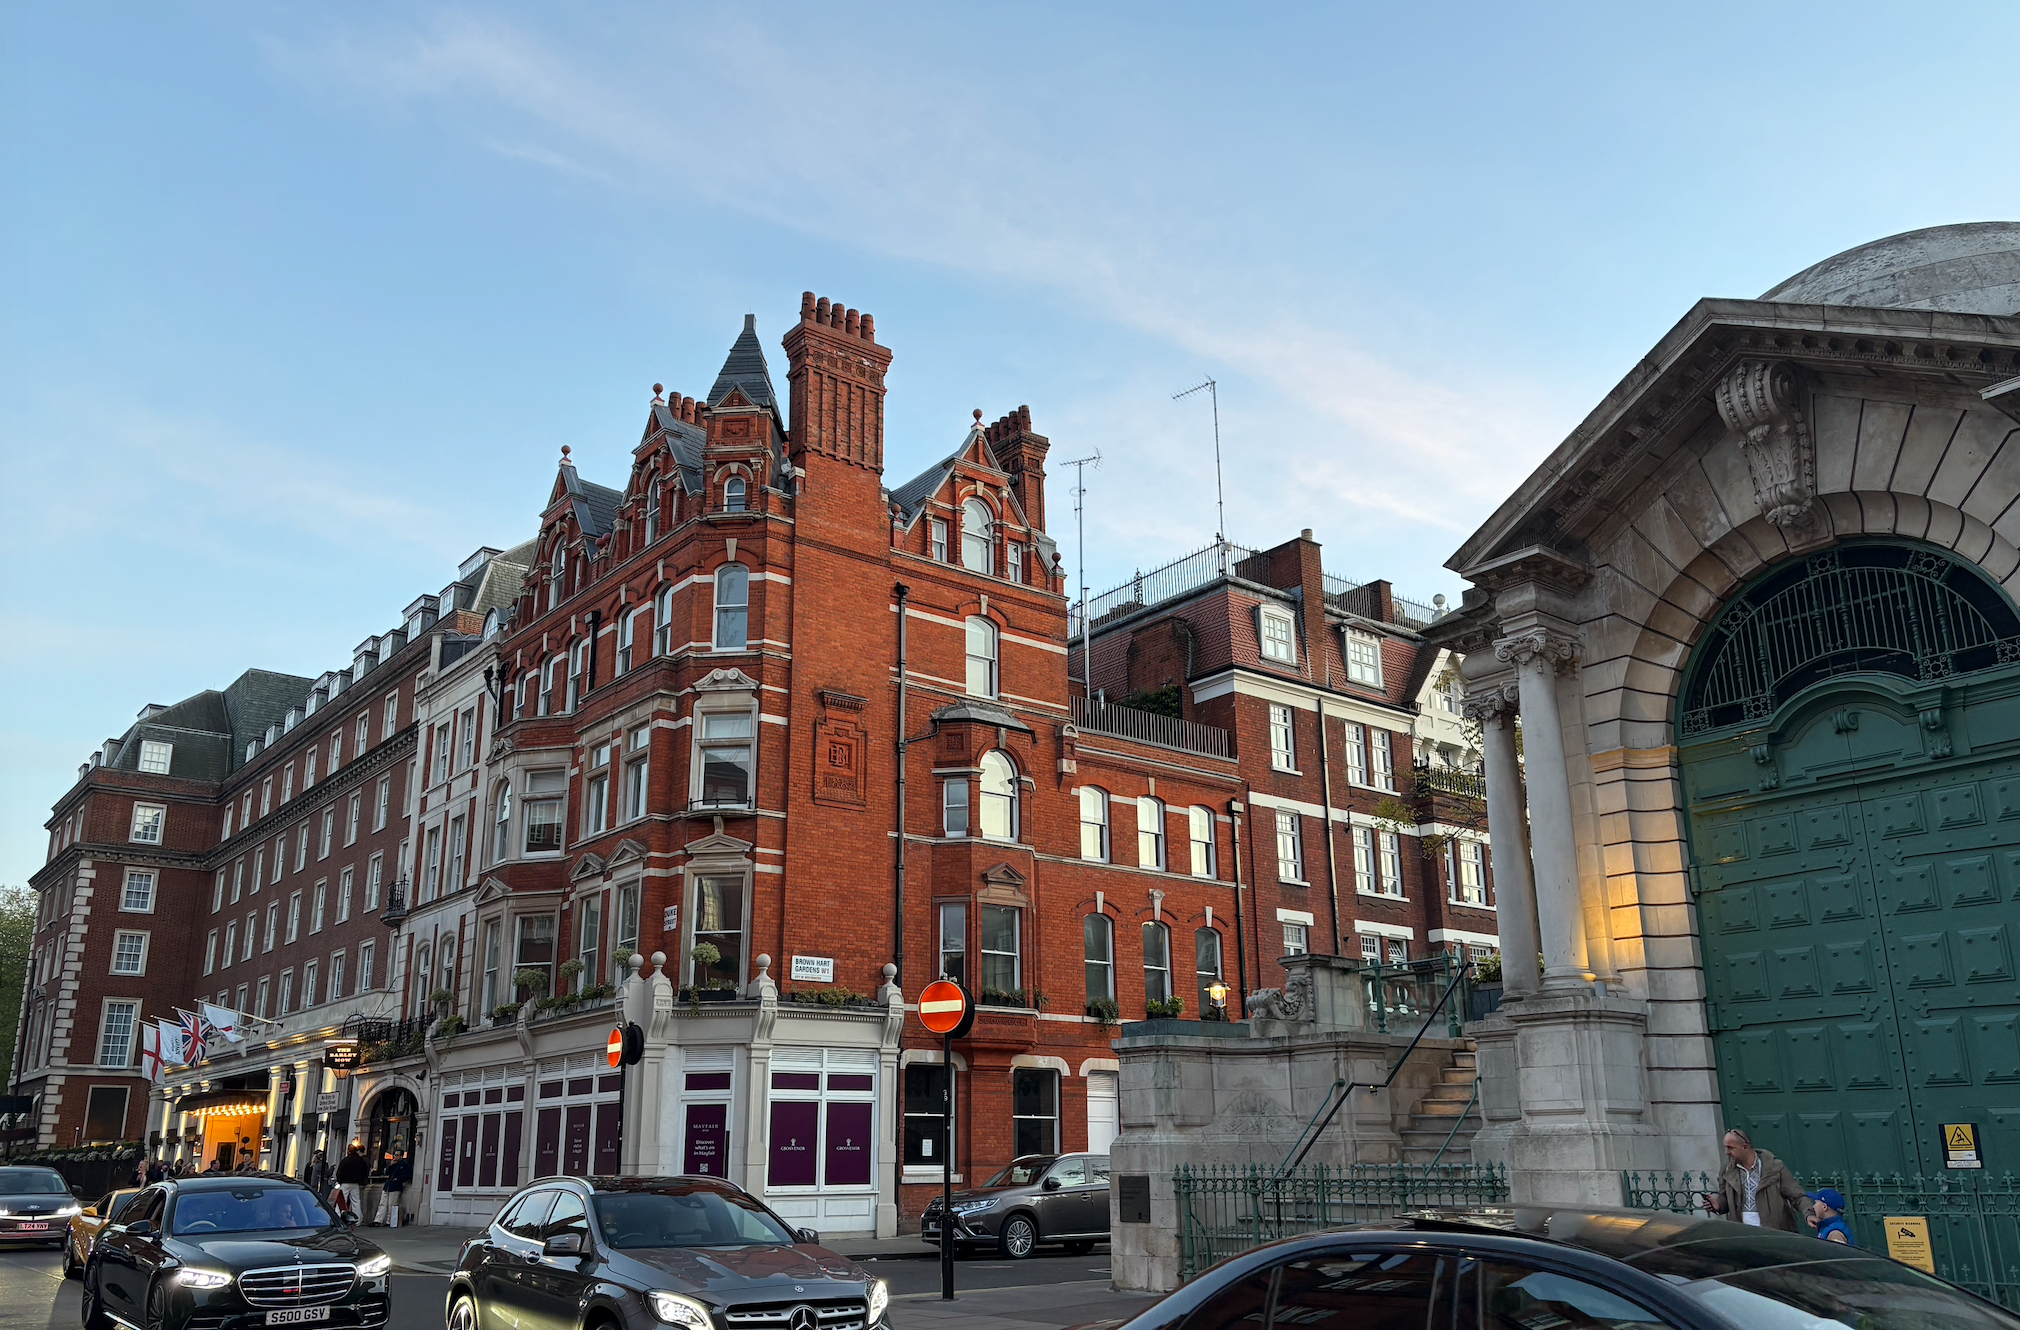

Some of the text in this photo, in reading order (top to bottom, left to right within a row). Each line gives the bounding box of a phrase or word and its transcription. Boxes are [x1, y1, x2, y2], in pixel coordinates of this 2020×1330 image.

[664, 908, 677, 918] DUKE
[795, 958, 815, 966] BROWN
[795, 965, 820, 974] GARDENS
[271, 1307, 326, 1323] S500 GSV
